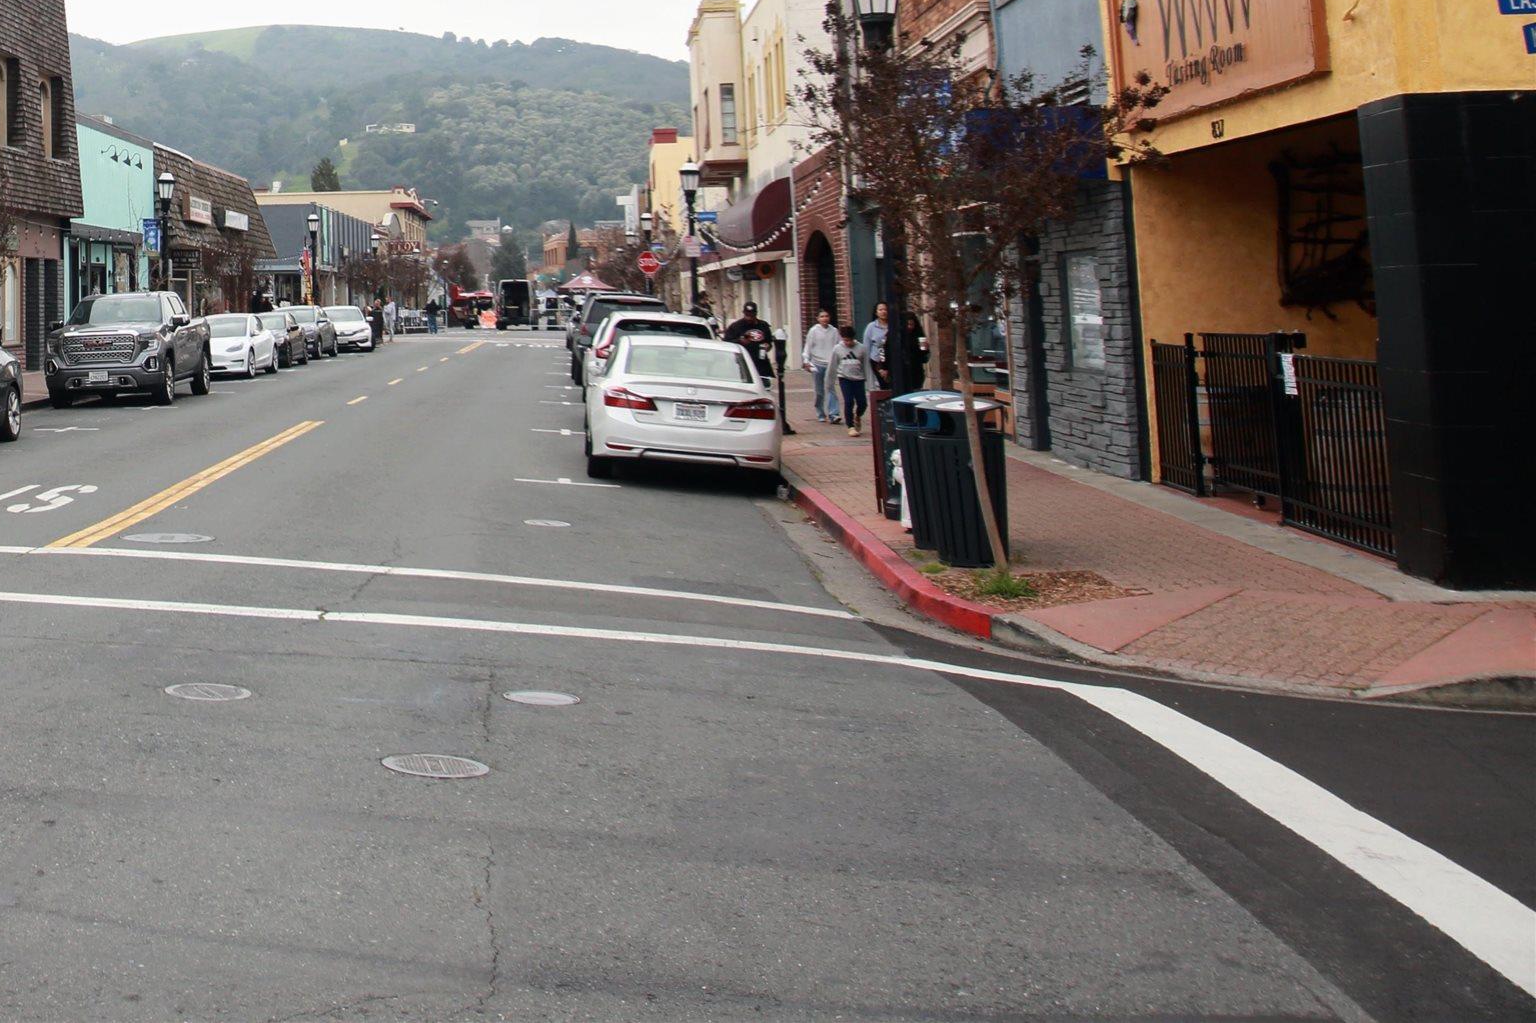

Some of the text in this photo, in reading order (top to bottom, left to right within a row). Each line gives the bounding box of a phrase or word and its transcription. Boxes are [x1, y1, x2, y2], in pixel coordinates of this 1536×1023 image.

[1166, 43, 1244, 86] Tasting Room
[1211, 119, 1224, 138] 837
